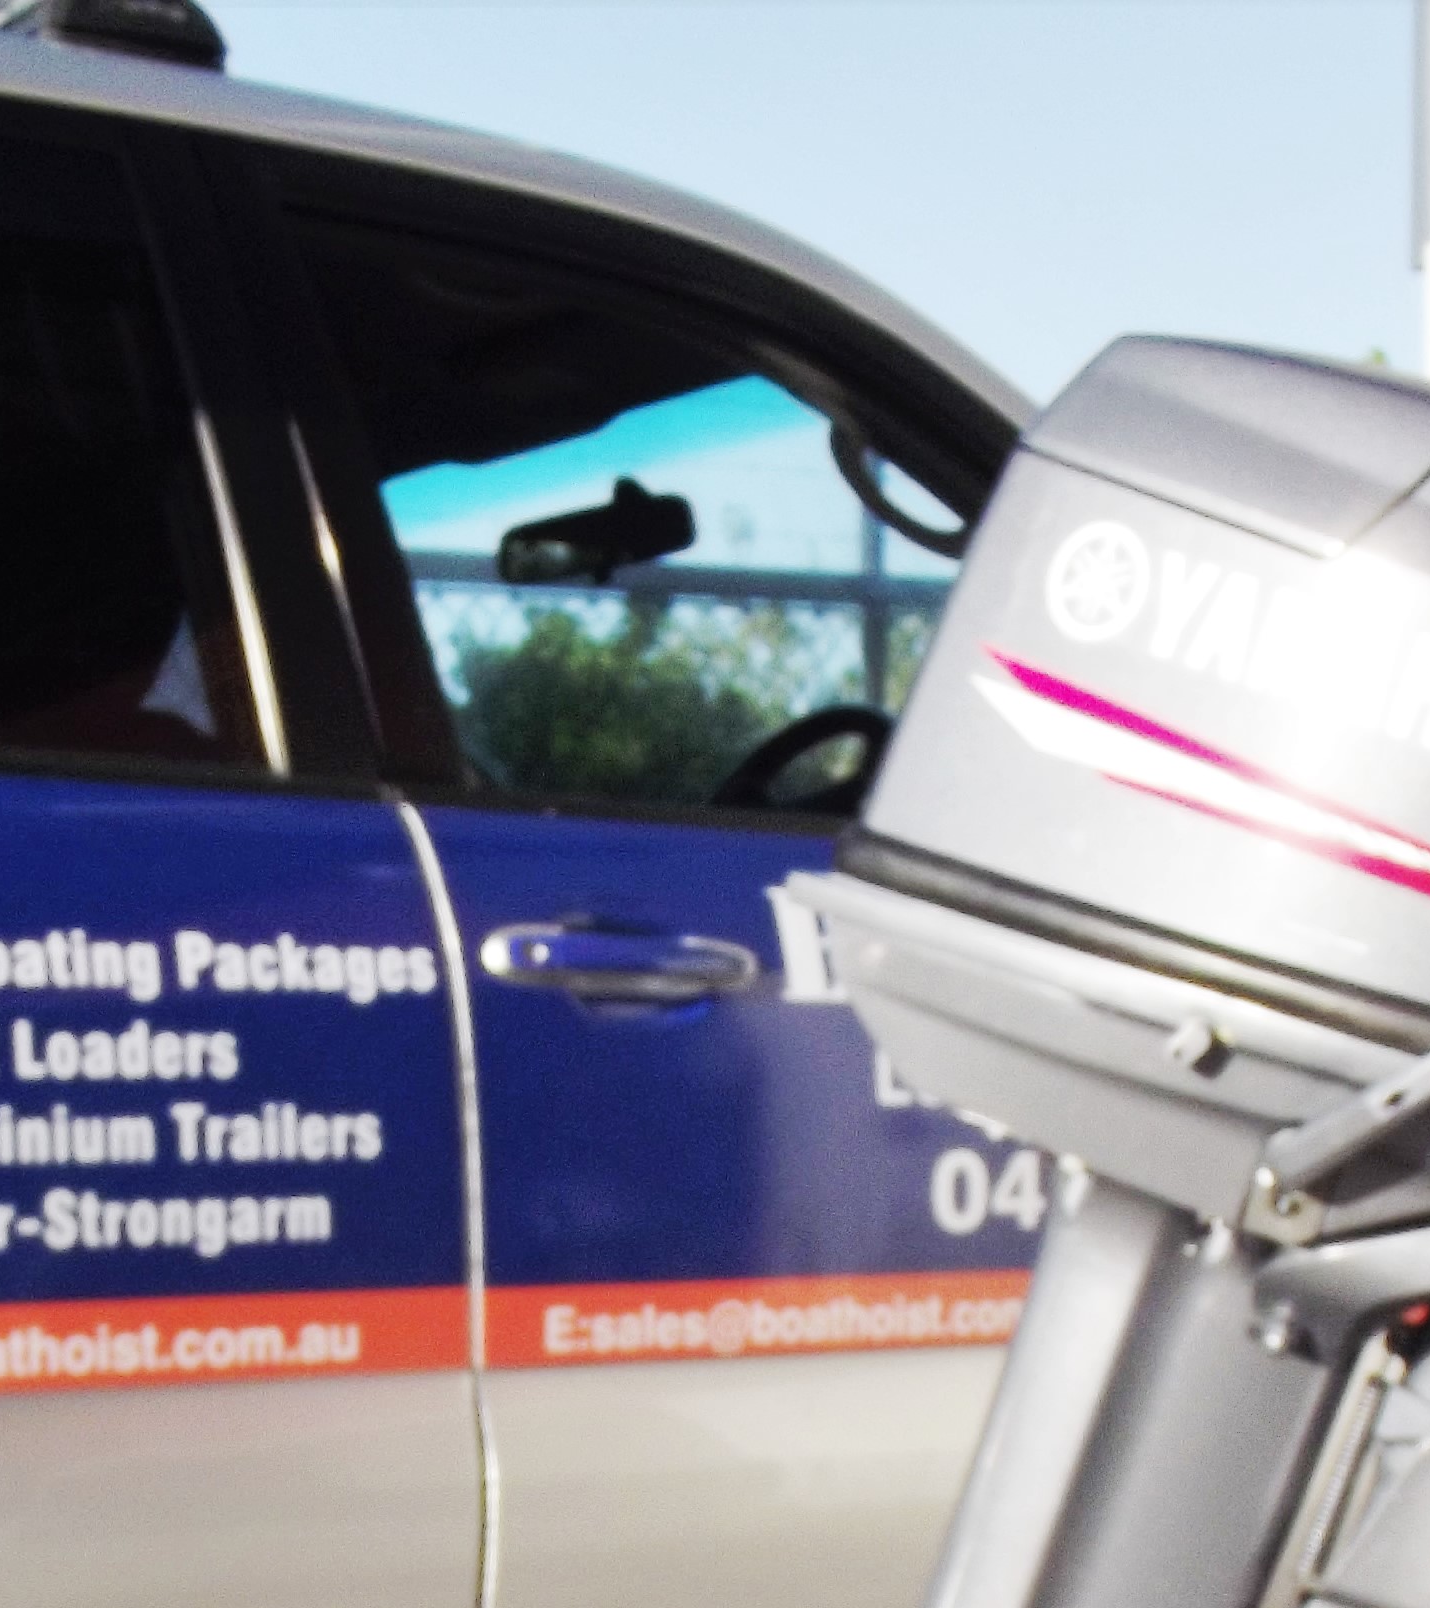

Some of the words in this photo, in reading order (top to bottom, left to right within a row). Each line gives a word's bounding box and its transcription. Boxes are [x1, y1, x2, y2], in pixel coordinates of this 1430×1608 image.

[174, 930, 437, 1003] Packages
[12, 1018, 239, 1081] Loaders
[170, 1101, 382, 1162] Trailers
